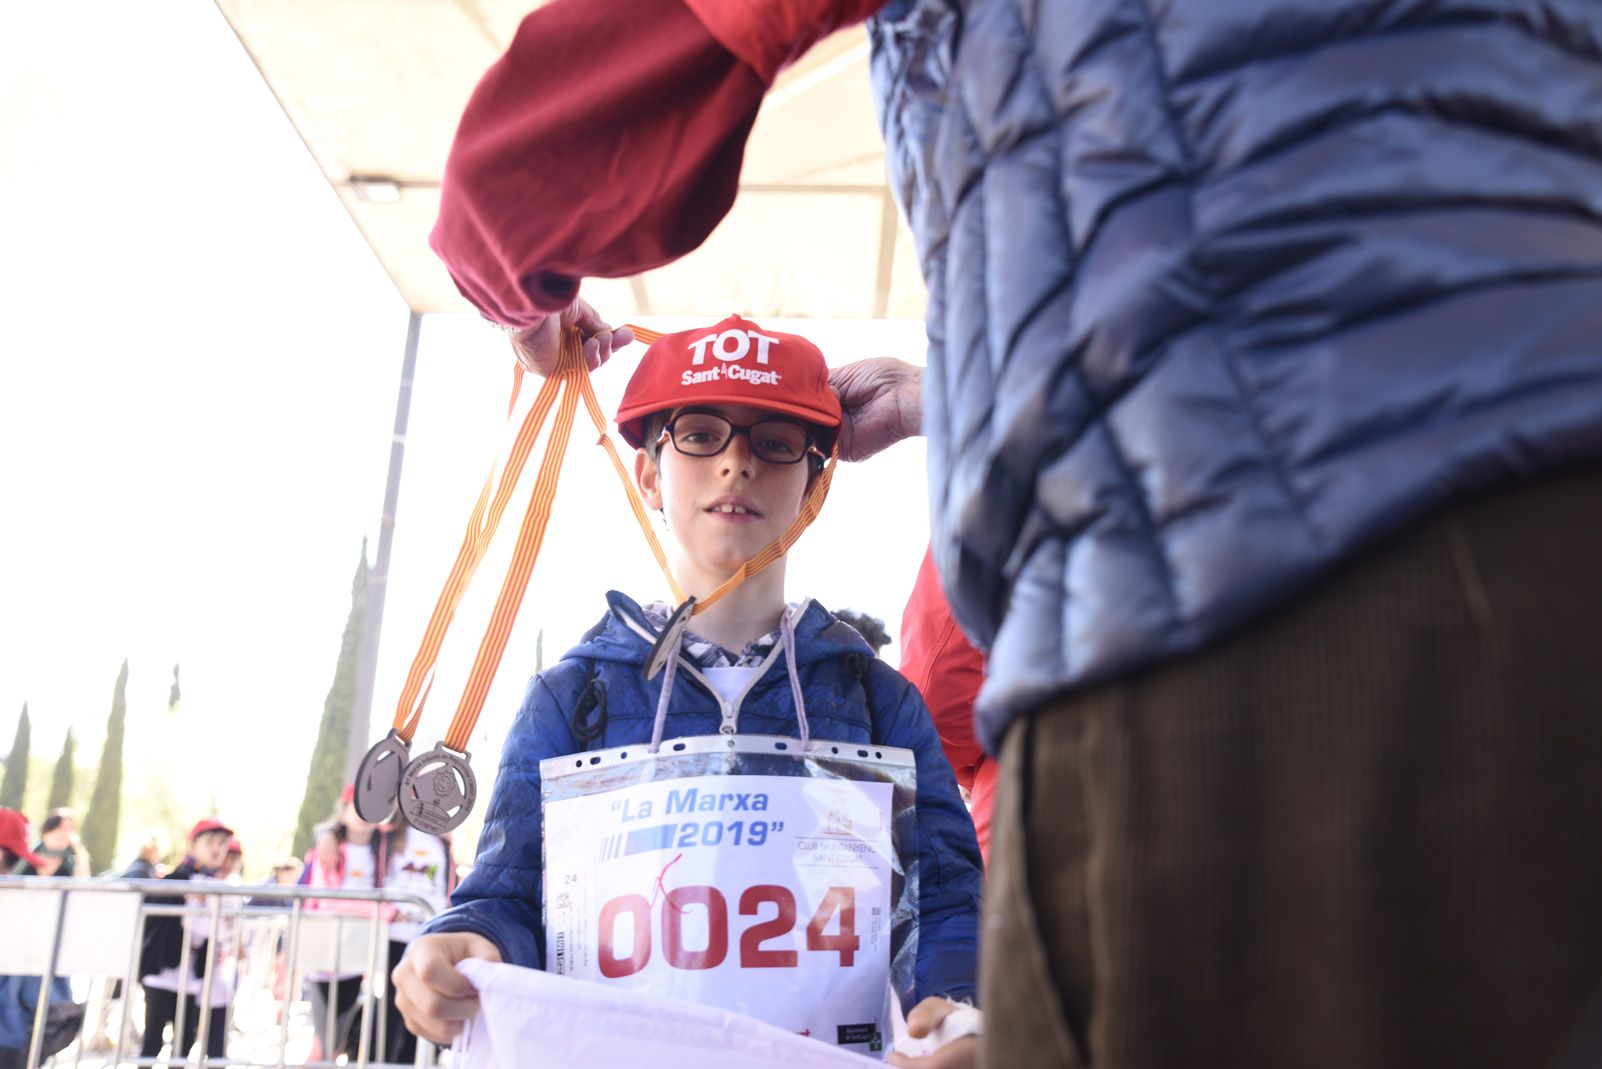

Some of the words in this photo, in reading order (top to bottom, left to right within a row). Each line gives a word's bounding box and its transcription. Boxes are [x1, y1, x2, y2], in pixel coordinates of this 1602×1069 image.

[687, 328, 780, 366] TOT
[681, 366, 720, 386] Sant
[727, 364, 779, 385] Cugat
[665, 787, 769, 815] Marxa
[797, 841, 819, 851] CLUB
[564, 873, 577, 885] 24
[597, 884, 860, 979] 0024
